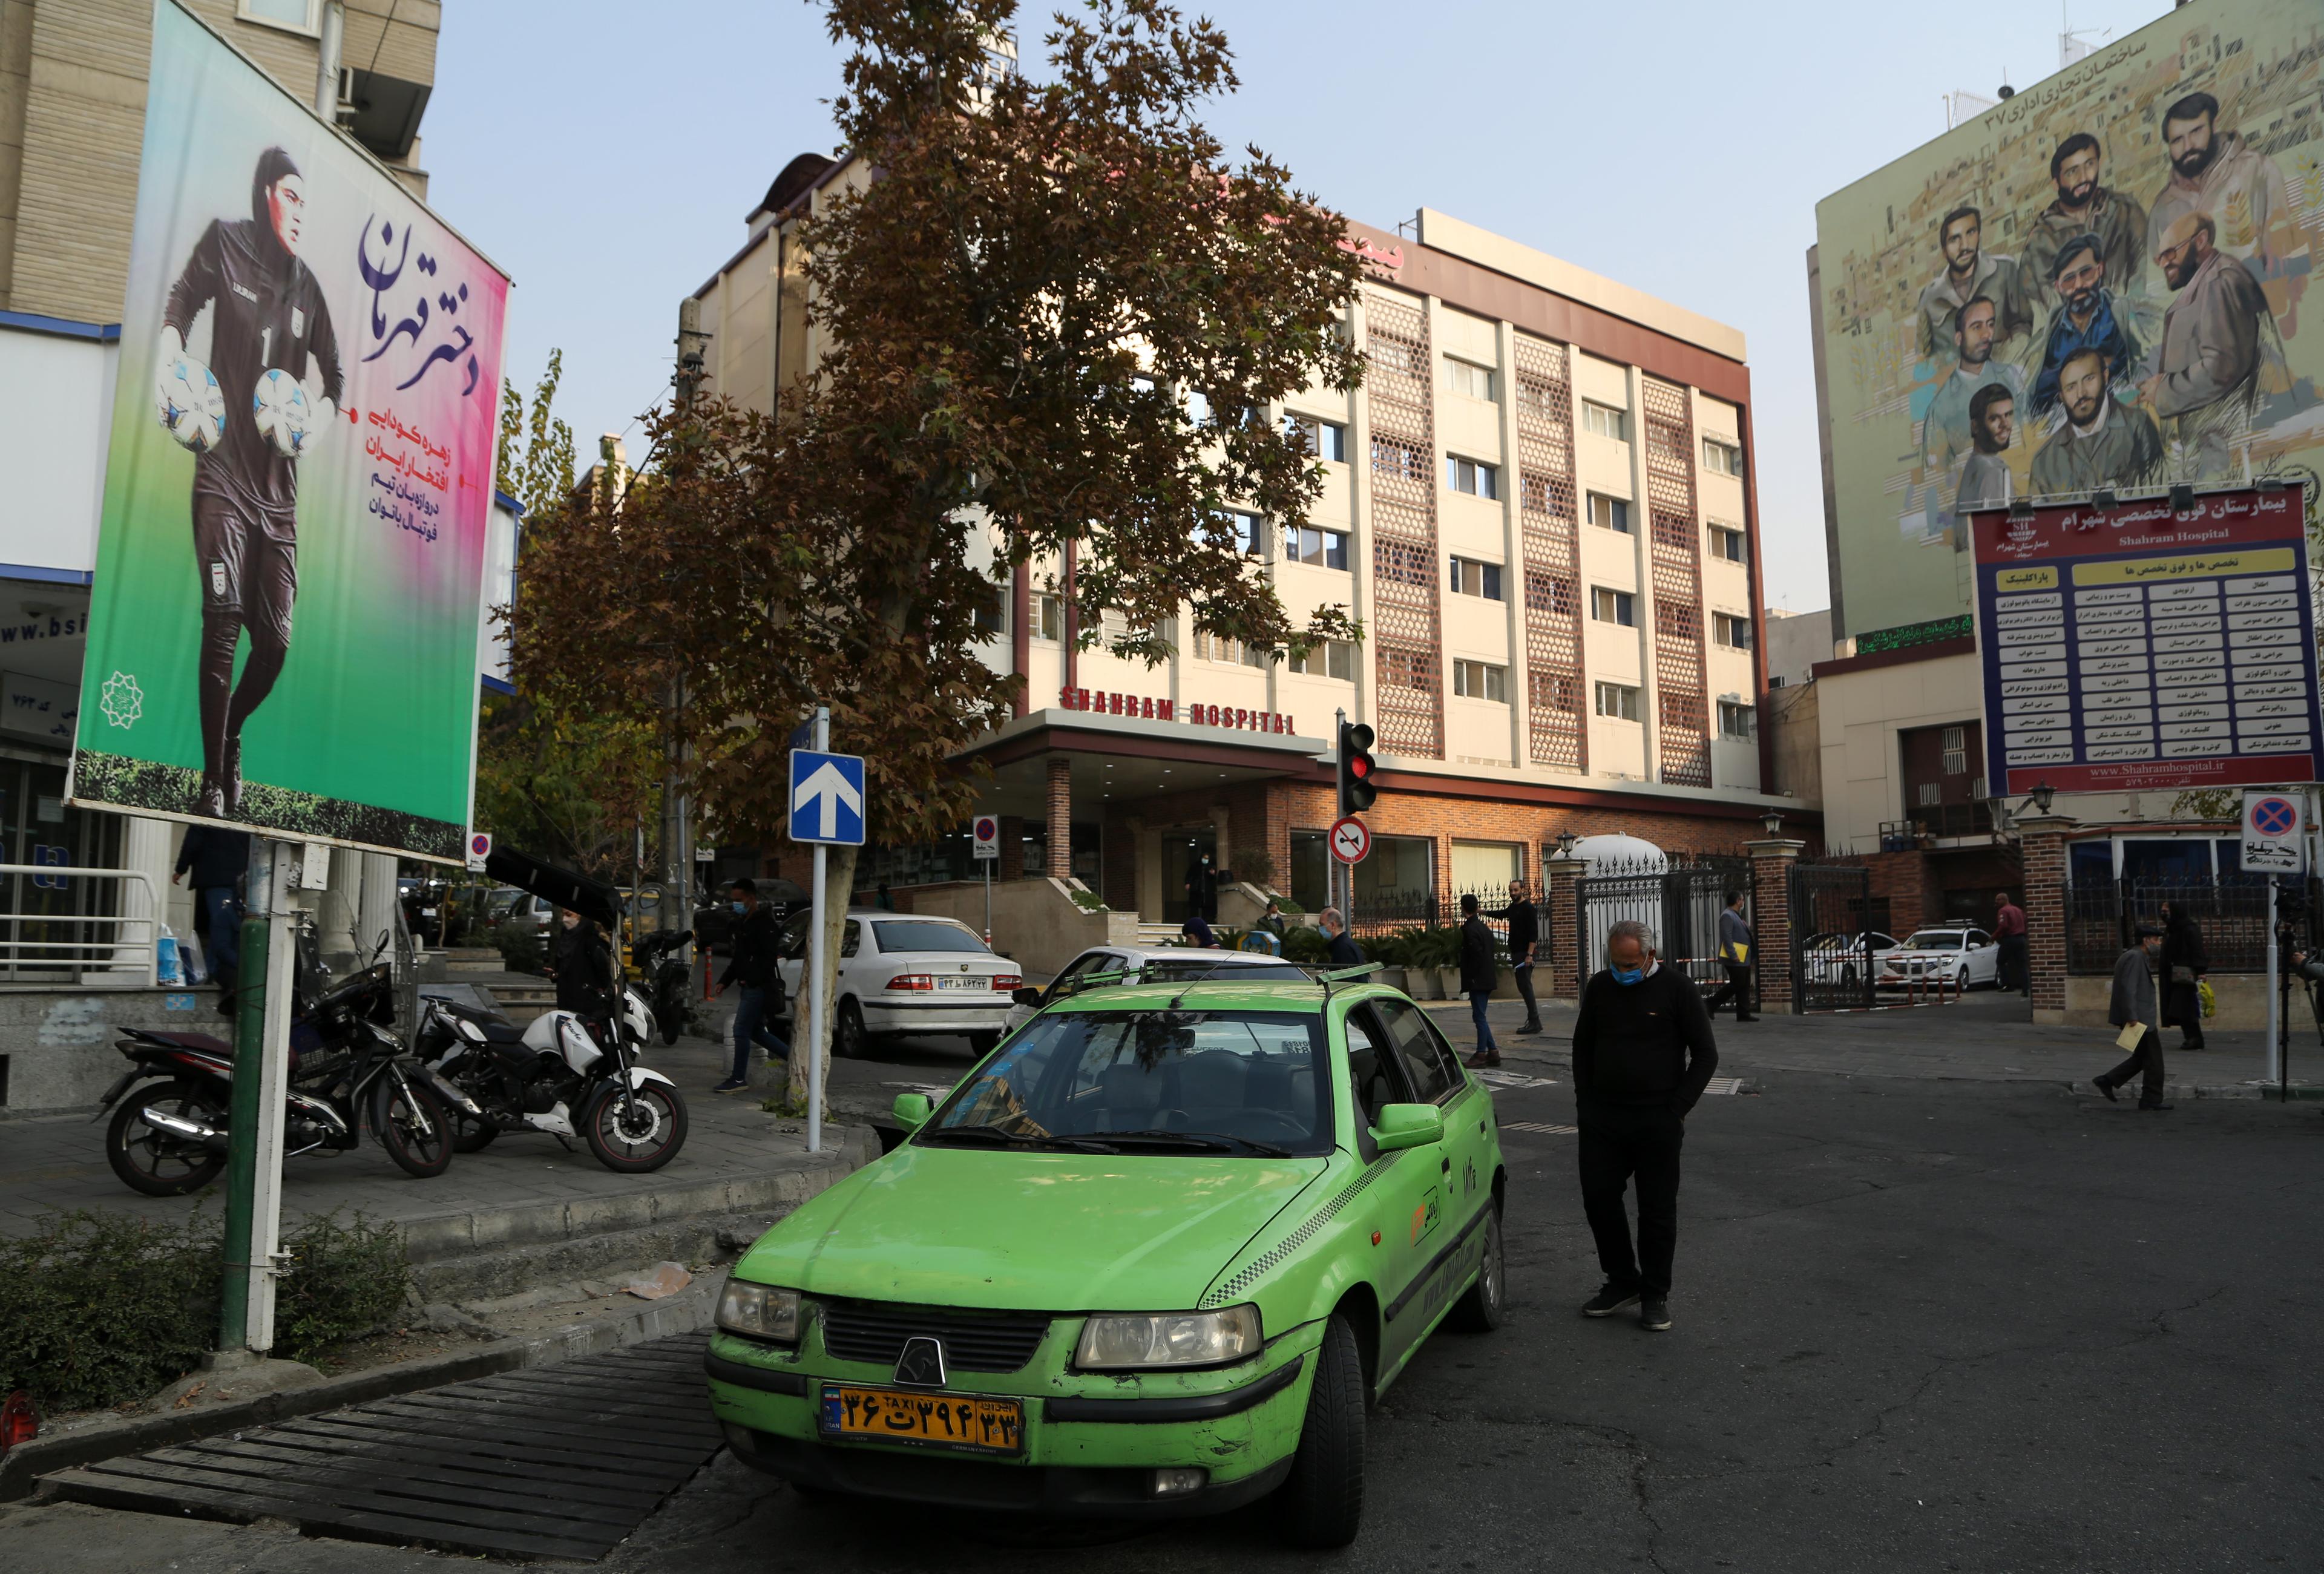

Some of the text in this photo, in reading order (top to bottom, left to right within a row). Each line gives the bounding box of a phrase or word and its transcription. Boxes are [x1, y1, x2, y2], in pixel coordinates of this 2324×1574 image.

[1984, 41, 2147, 131] ساختمان تجاری اداری ۳۷
[358, 212, 479, 396] دختر قهرمان
[261, 325, 272, 368] 1
[369, 407, 451, 468] زهره کودایی
[366, 435, 449, 493] افتخار ایران
[371, 473, 396, 494] تیم
[369, 497, 437, 543] فوتبال بانوان
[2061, 495, 2286, 531] بیمارستان فوق تخصصی شهرام
[2119, 528, 2230, 546] Shahram Hospital
[1997, 540, 2049, 553] بیمارستان شهرام
[2125, 566, 2135, 575] ها
[2137, 563, 2167, 576] تخصص
[2170, 562, 2186, 574] فوق
[2196, 561, 2205, 569] ها
[2208, 557, 2239, 570] تخصص
[2006, 571, 2049, 585] پاراکلینیک
[2252, 581, 2269, 589] اطفال
[2268, 598, 2290, 606] جراحی
[2245, 634, 2262, 643] اطفال
[2278, 668, 2292, 677] خون
[2038, 683, 2066, 691] رادیولوژی
[2111, 678, 2129, 687] داخلی
[38, 701, 51, 712] کد
[1060, 685, 1296, 736] SHAHRAM HOSPITAL
[2036, 717, 2055, 726] شنوایی
[2090, 760, 2225, 776] www.Shahramhospital.ir
[884, 1396, 915, 1411] TAXI
[844, 1394, 879, 1427] ۳۶
[917, 1399, 973, 1437] ۳۹۴
[980, 1412, 1015, 1444] ۳۳
